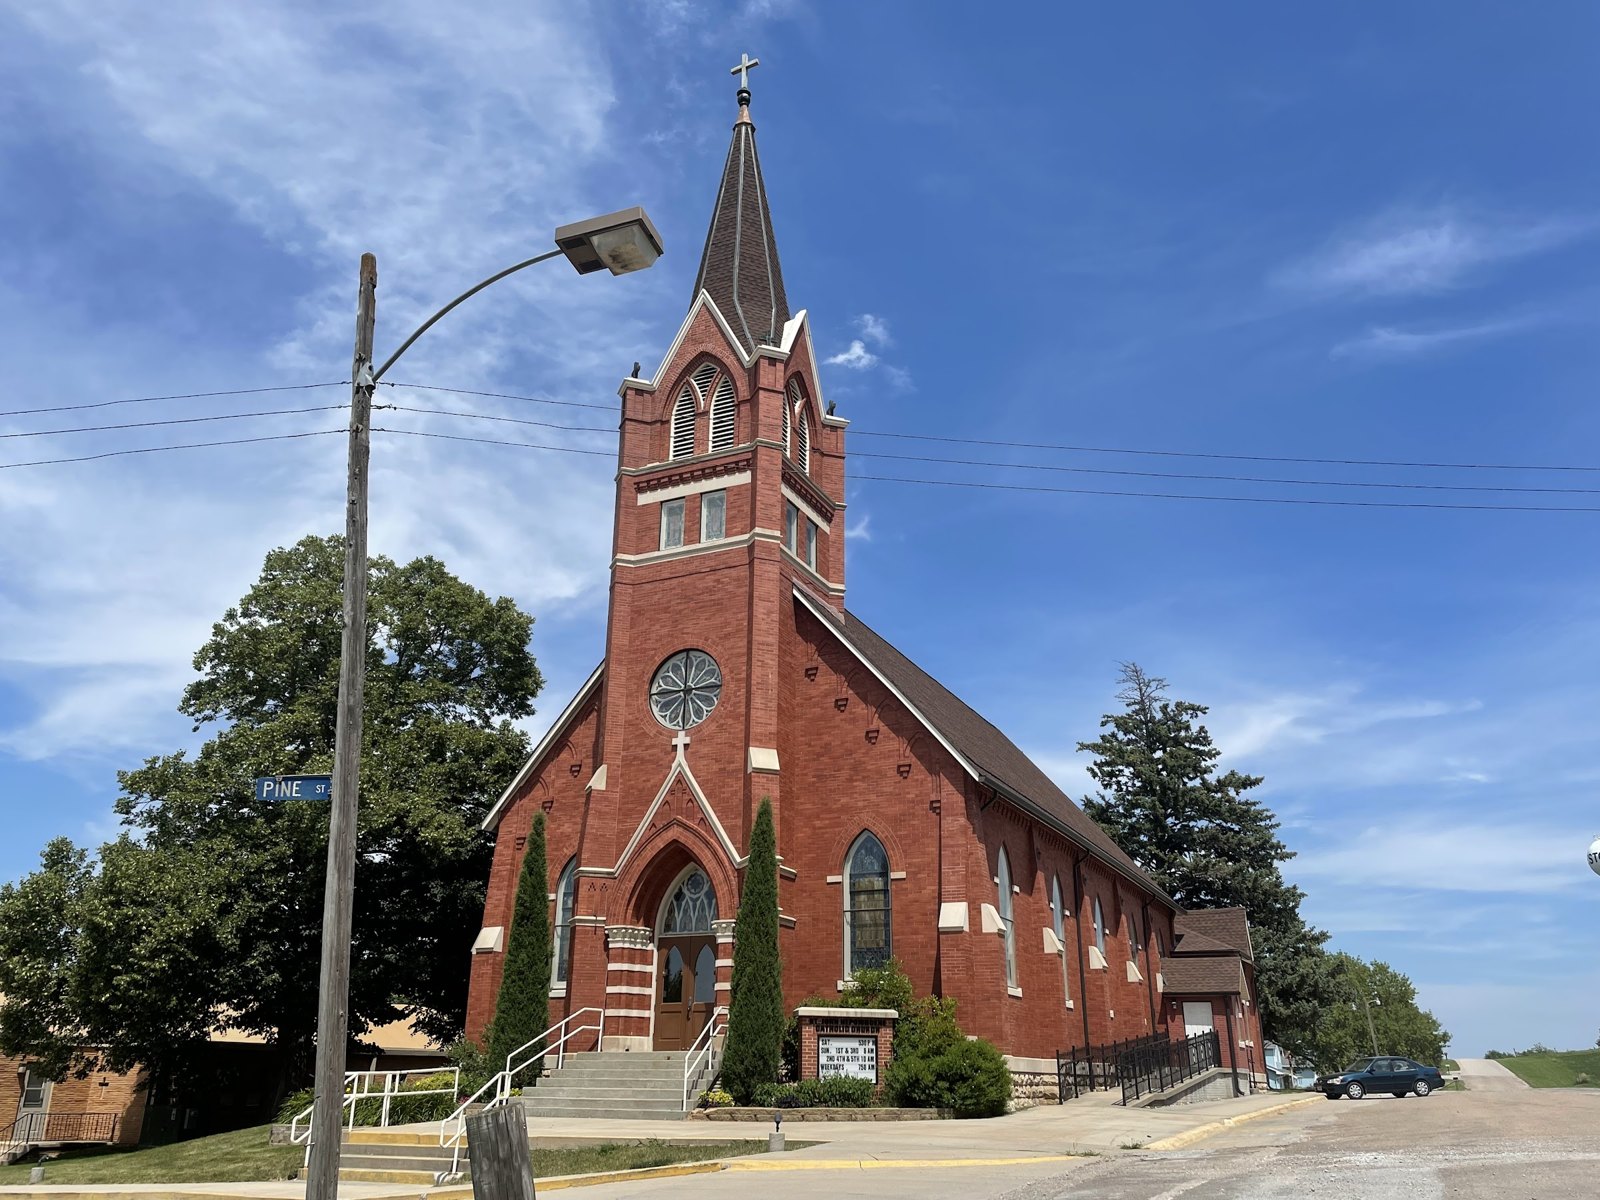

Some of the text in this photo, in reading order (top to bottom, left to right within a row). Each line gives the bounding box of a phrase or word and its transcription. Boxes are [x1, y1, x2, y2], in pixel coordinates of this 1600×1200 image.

[263, 780, 326, 798] PINE ST
[820, 1063, 844, 1071] WEEKDAYS
[868, 1063, 875, 1071] AM
